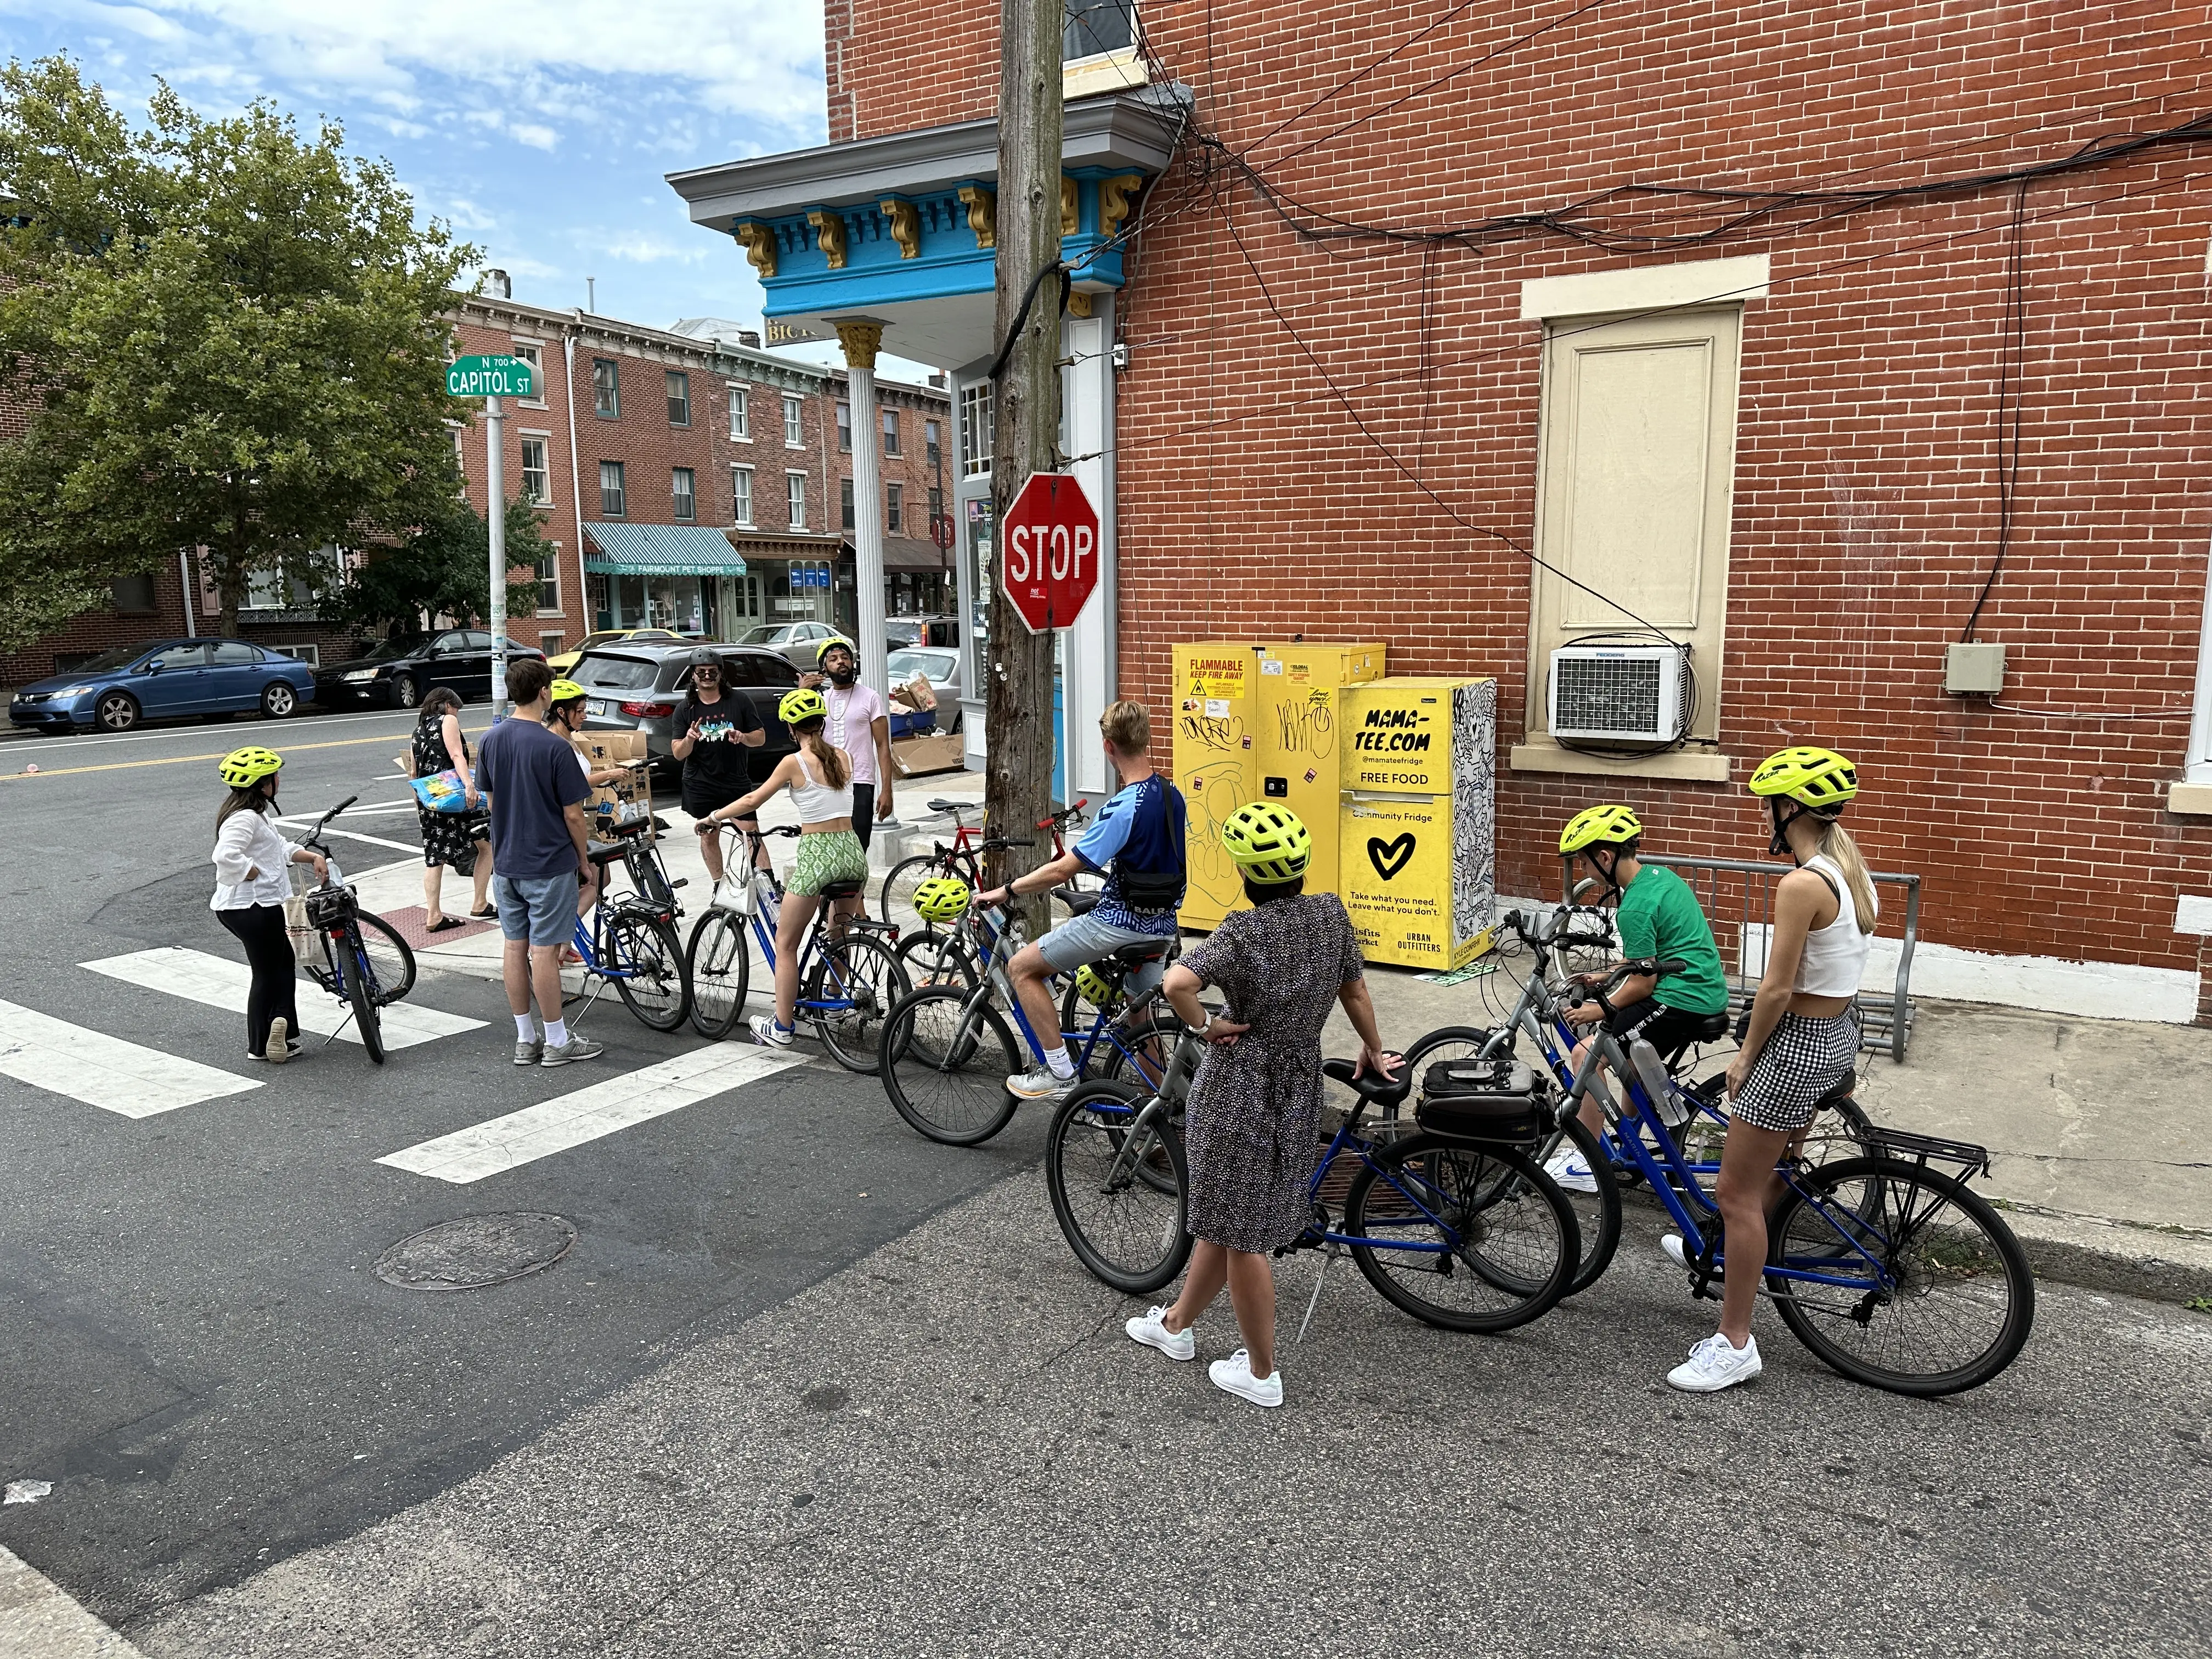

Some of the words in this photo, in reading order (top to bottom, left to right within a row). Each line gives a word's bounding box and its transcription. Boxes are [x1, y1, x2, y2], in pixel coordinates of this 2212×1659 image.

[482, 357, 489, 368] N
[493, 358, 509, 366] 700
[449, 371, 511, 393] CAPITOL
[517, 378, 529, 393] ST
[1011, 524, 1093, 582] STOP
[1190, 659, 1243, 671] FLAMMABLE
[1208, 671, 1223, 679] FIRE
[1224, 672, 1244, 680] AWAY
[1365, 709, 1430, 728] MAMA-
[1355, 731, 1431, 752] TEE.COM
[1362, 756, 1424, 766] @mamateefridge
[1361, 772, 1389, 783] FREE
[1392, 774, 1429, 785] FOOD
[1758, 770, 1780, 783] LAZER
[1404, 813, 1432, 823] Fridge
[1224, 831, 1238, 842] LAZER
[1350, 891, 1369, 900] Take
[1371, 894, 1392, 902] what
[1412, 898, 1437, 906] need.
[1348, 901, 1372, 910] Leave
[1374, 904, 1395, 912] what
[1352, 927, 1381, 937] isfits
[1407, 932, 1431, 942] URBAN
[1355, 938, 1379, 946] arket
[1397, 940, 1441, 952] OUTFITTERS
[1454, 949, 1463, 960] KYLE
[1624, 1132, 1642, 1158] MARIN
